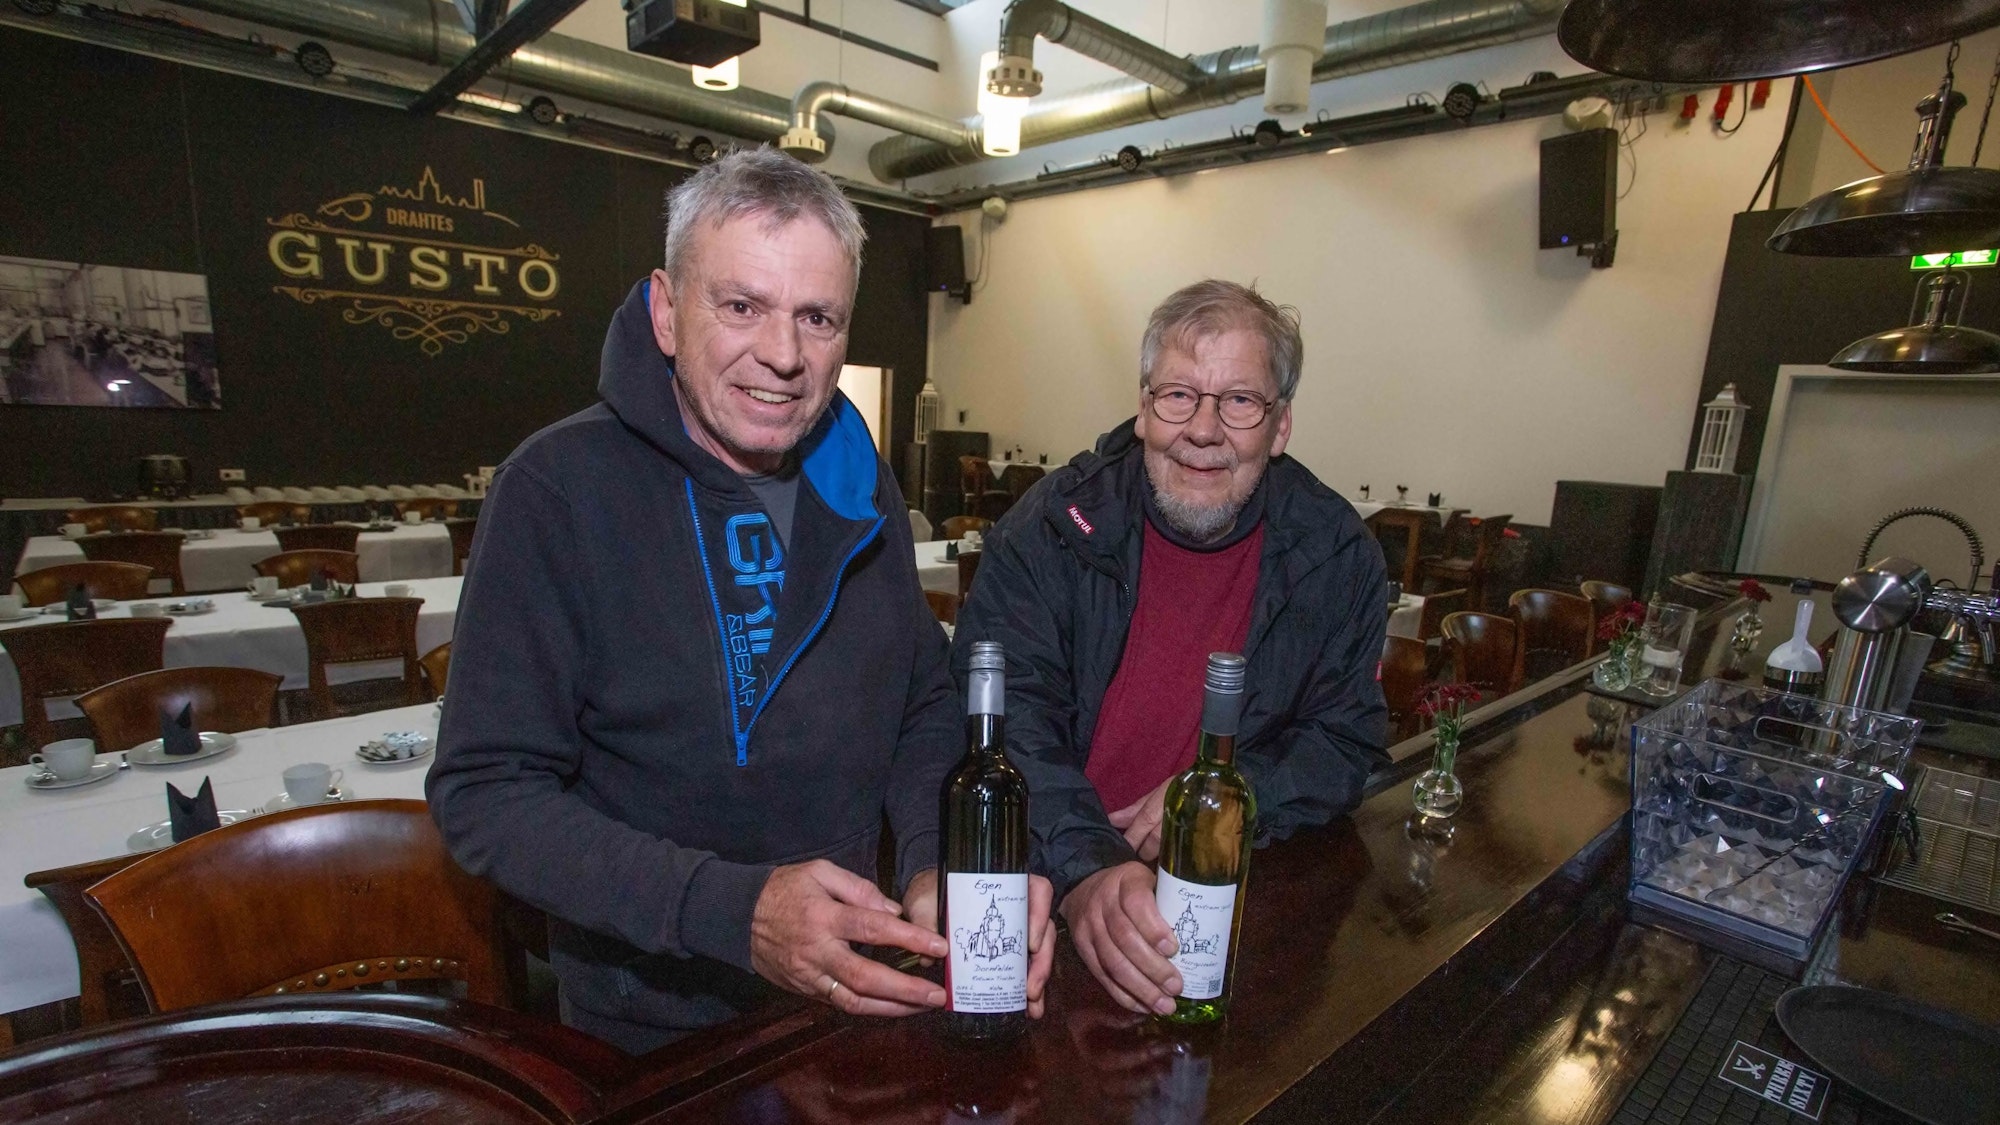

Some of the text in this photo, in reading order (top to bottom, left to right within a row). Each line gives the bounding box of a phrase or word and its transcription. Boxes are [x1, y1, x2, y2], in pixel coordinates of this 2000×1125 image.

[268, 230, 560, 299] GUSTO
[1069, 507, 1092, 534] MOTUL
[974, 879, 1003, 895] Egen
[1177, 887, 1203, 902] Egen
[1763, 1059, 1794, 1102] THREE
[1788, 1070, 1817, 1111] SIXTY
